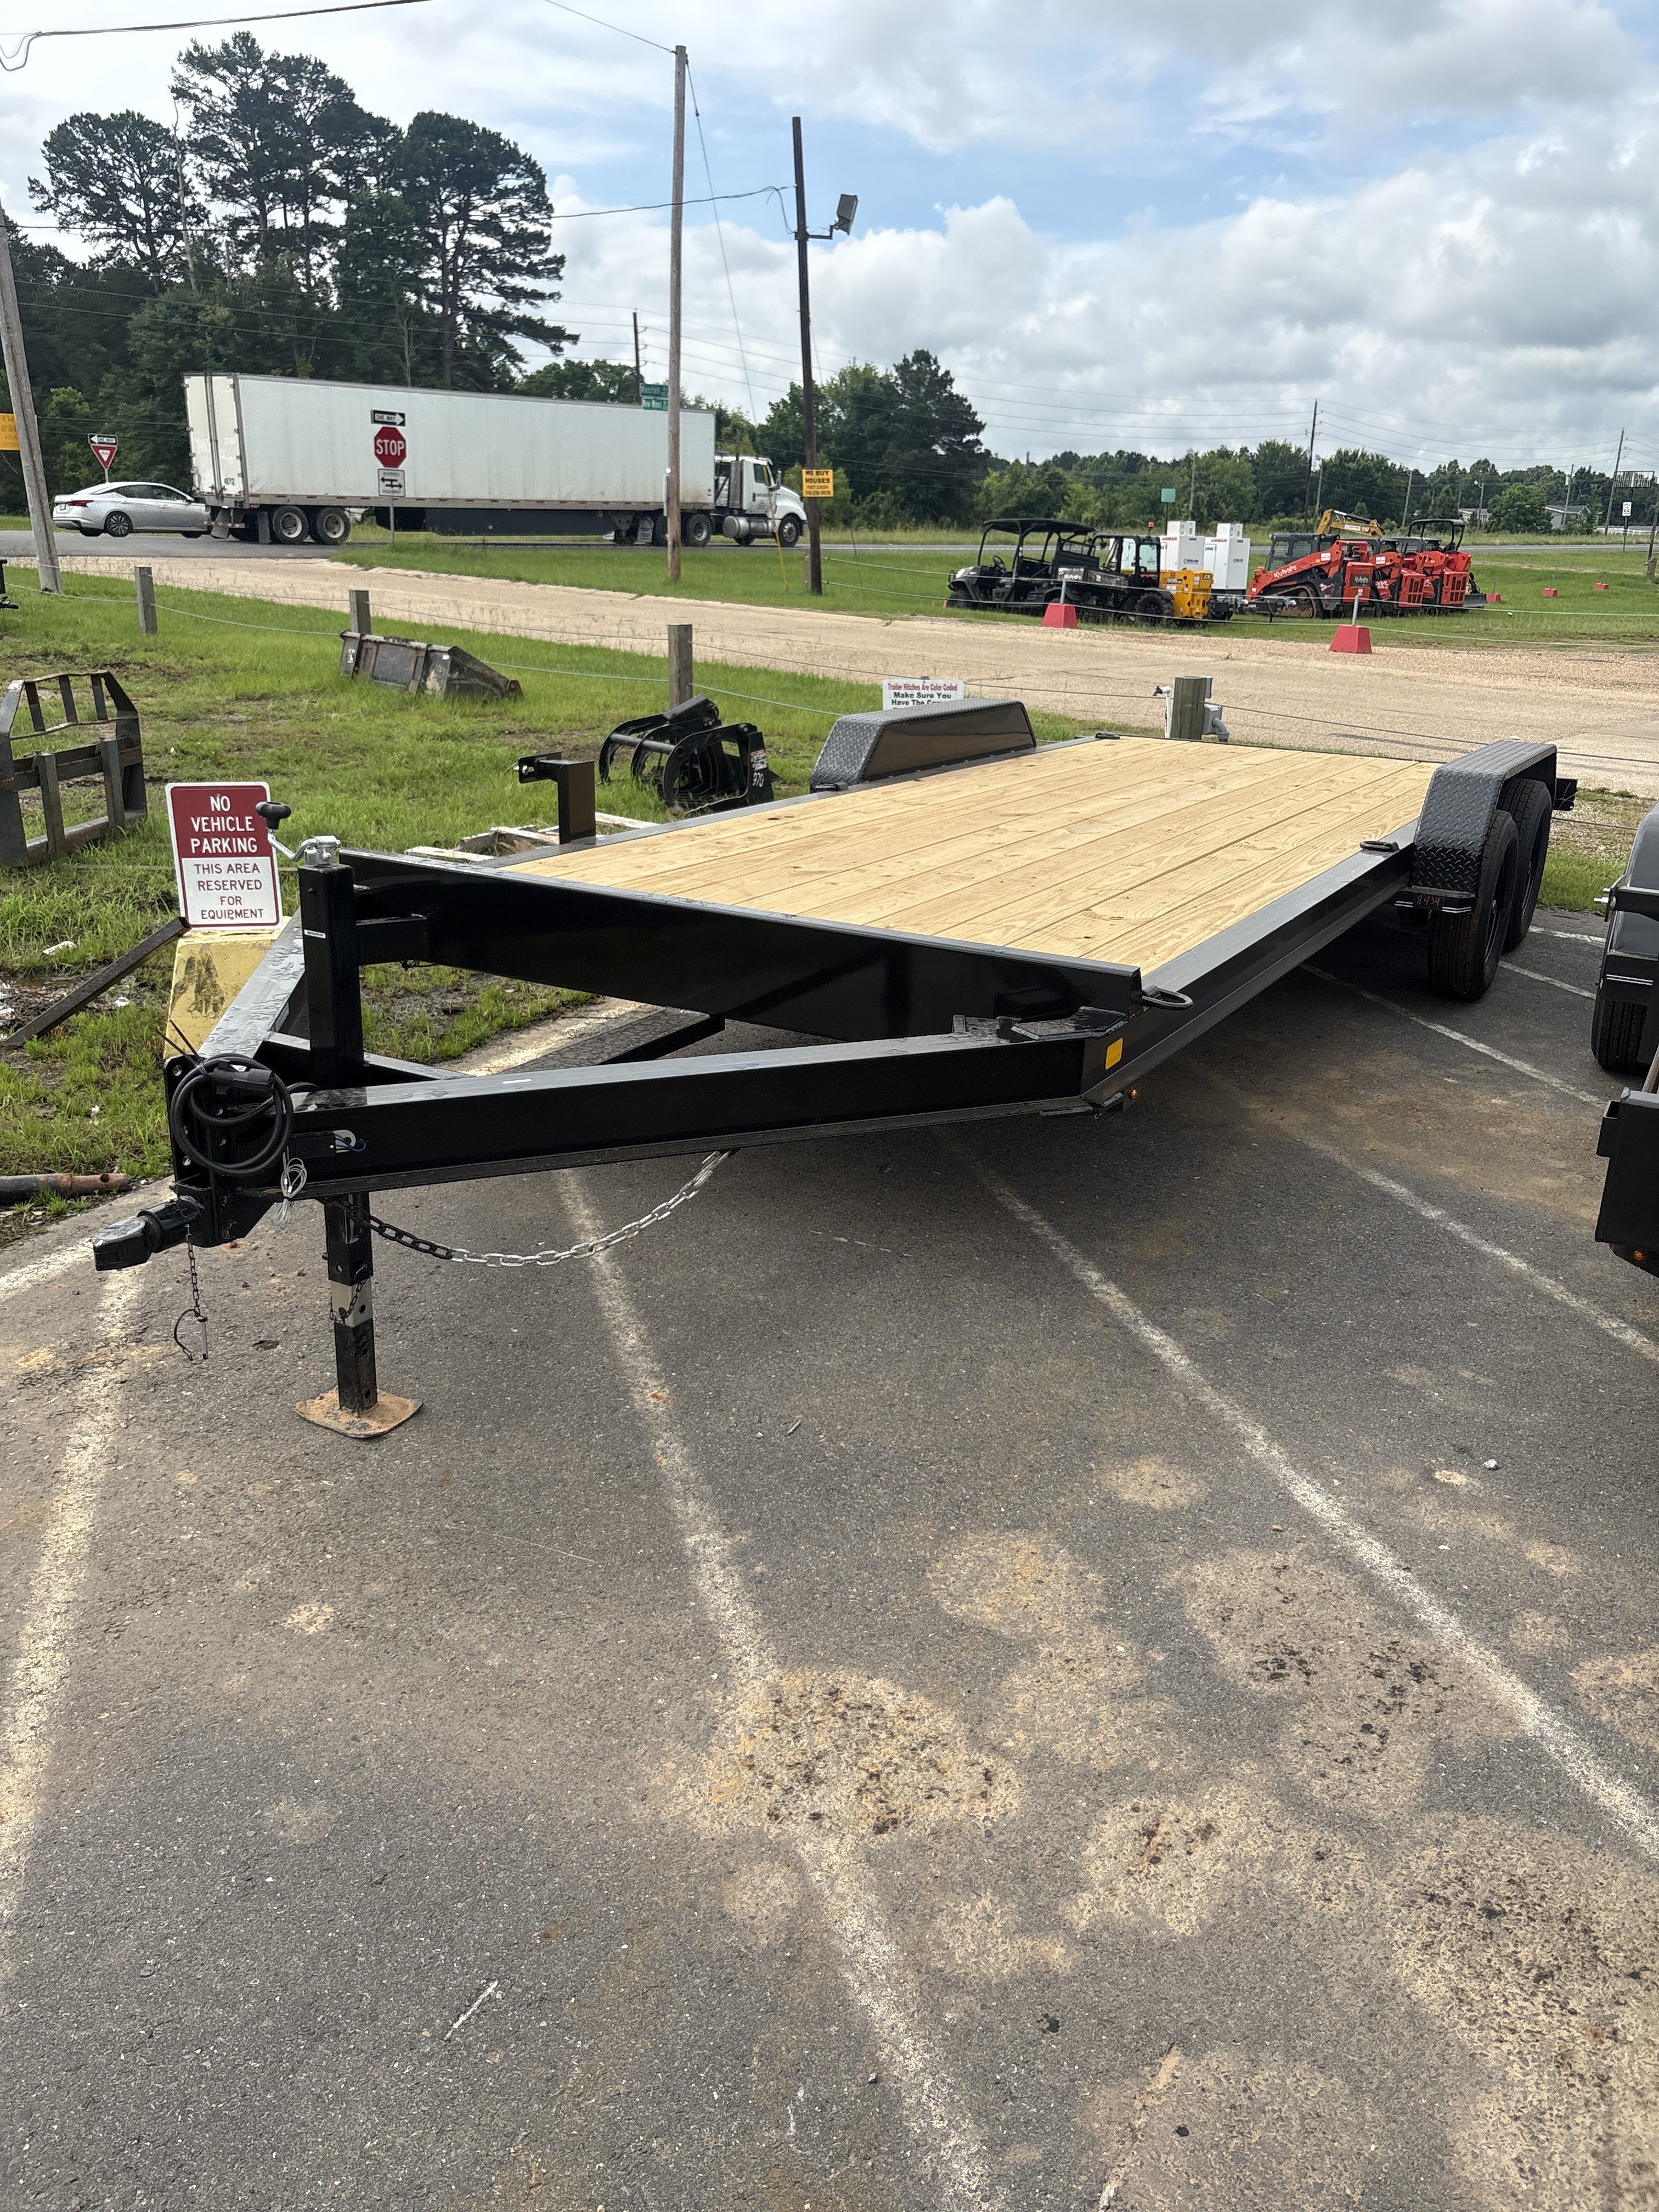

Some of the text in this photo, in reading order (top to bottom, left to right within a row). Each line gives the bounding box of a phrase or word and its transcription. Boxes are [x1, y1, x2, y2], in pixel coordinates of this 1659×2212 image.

[376, 439, 404, 456] STOP
[1273, 566, 1297, 578] Kubota
[210, 795, 231, 812] NO
[190, 816, 255, 832] VEHICLE
[190, 837, 258, 854] PARKING
[194, 863, 261, 874] THIS AREA
[198, 879, 262, 891] RESERVED
[220, 896, 242, 906] FOR
[1417, 895, 1441, 908] 8434
[201, 909, 264, 920] EQUIPMENT
